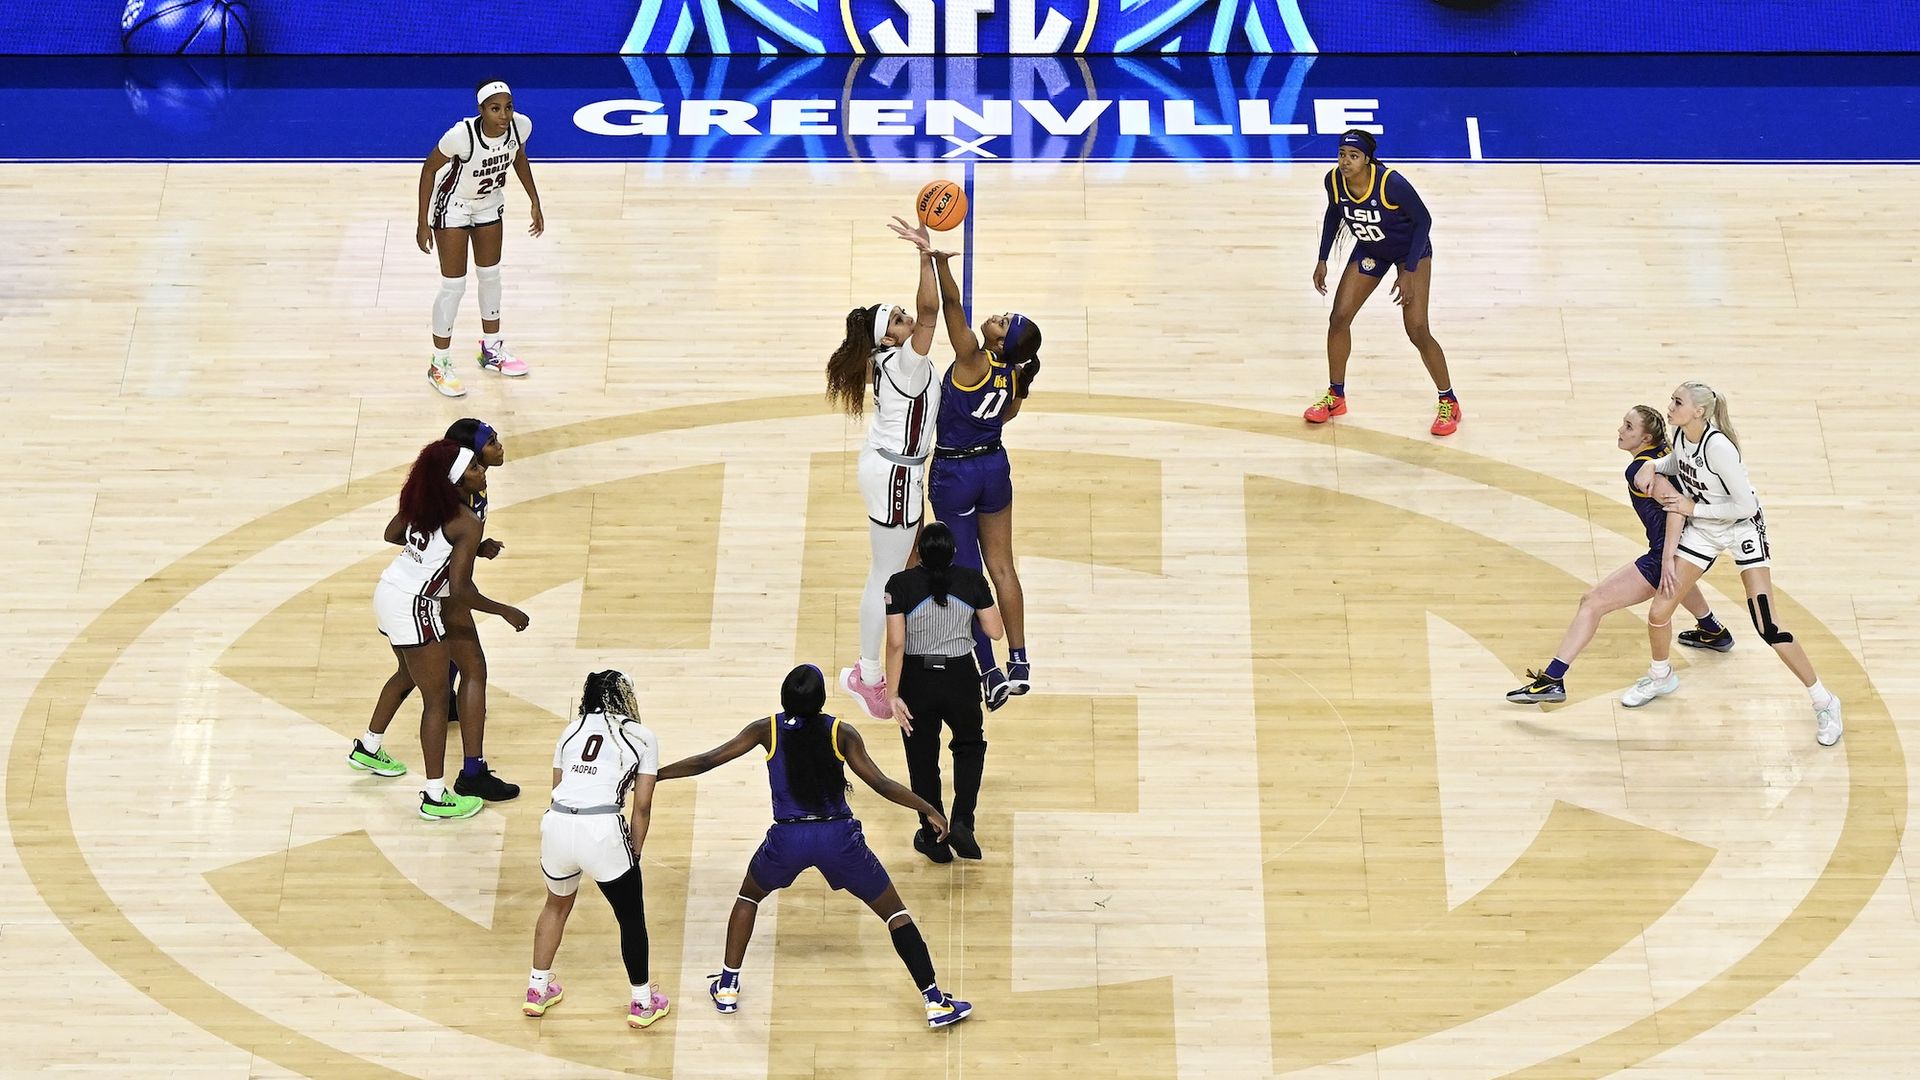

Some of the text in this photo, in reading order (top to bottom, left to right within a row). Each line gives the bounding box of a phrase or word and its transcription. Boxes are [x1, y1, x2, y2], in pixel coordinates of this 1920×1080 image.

[573, 98, 1383, 137] GREENVILLE
[481, 152, 510, 168] SOUTH
[934, 192, 953, 217] NCAA
[1343, 206, 1382, 224] LSU
[1352, 223, 1386, 242] 20
[895, 479, 903, 511] USC
[581, 734, 603, 762] 0
[570, 764, 597, 776] PAOPAO
